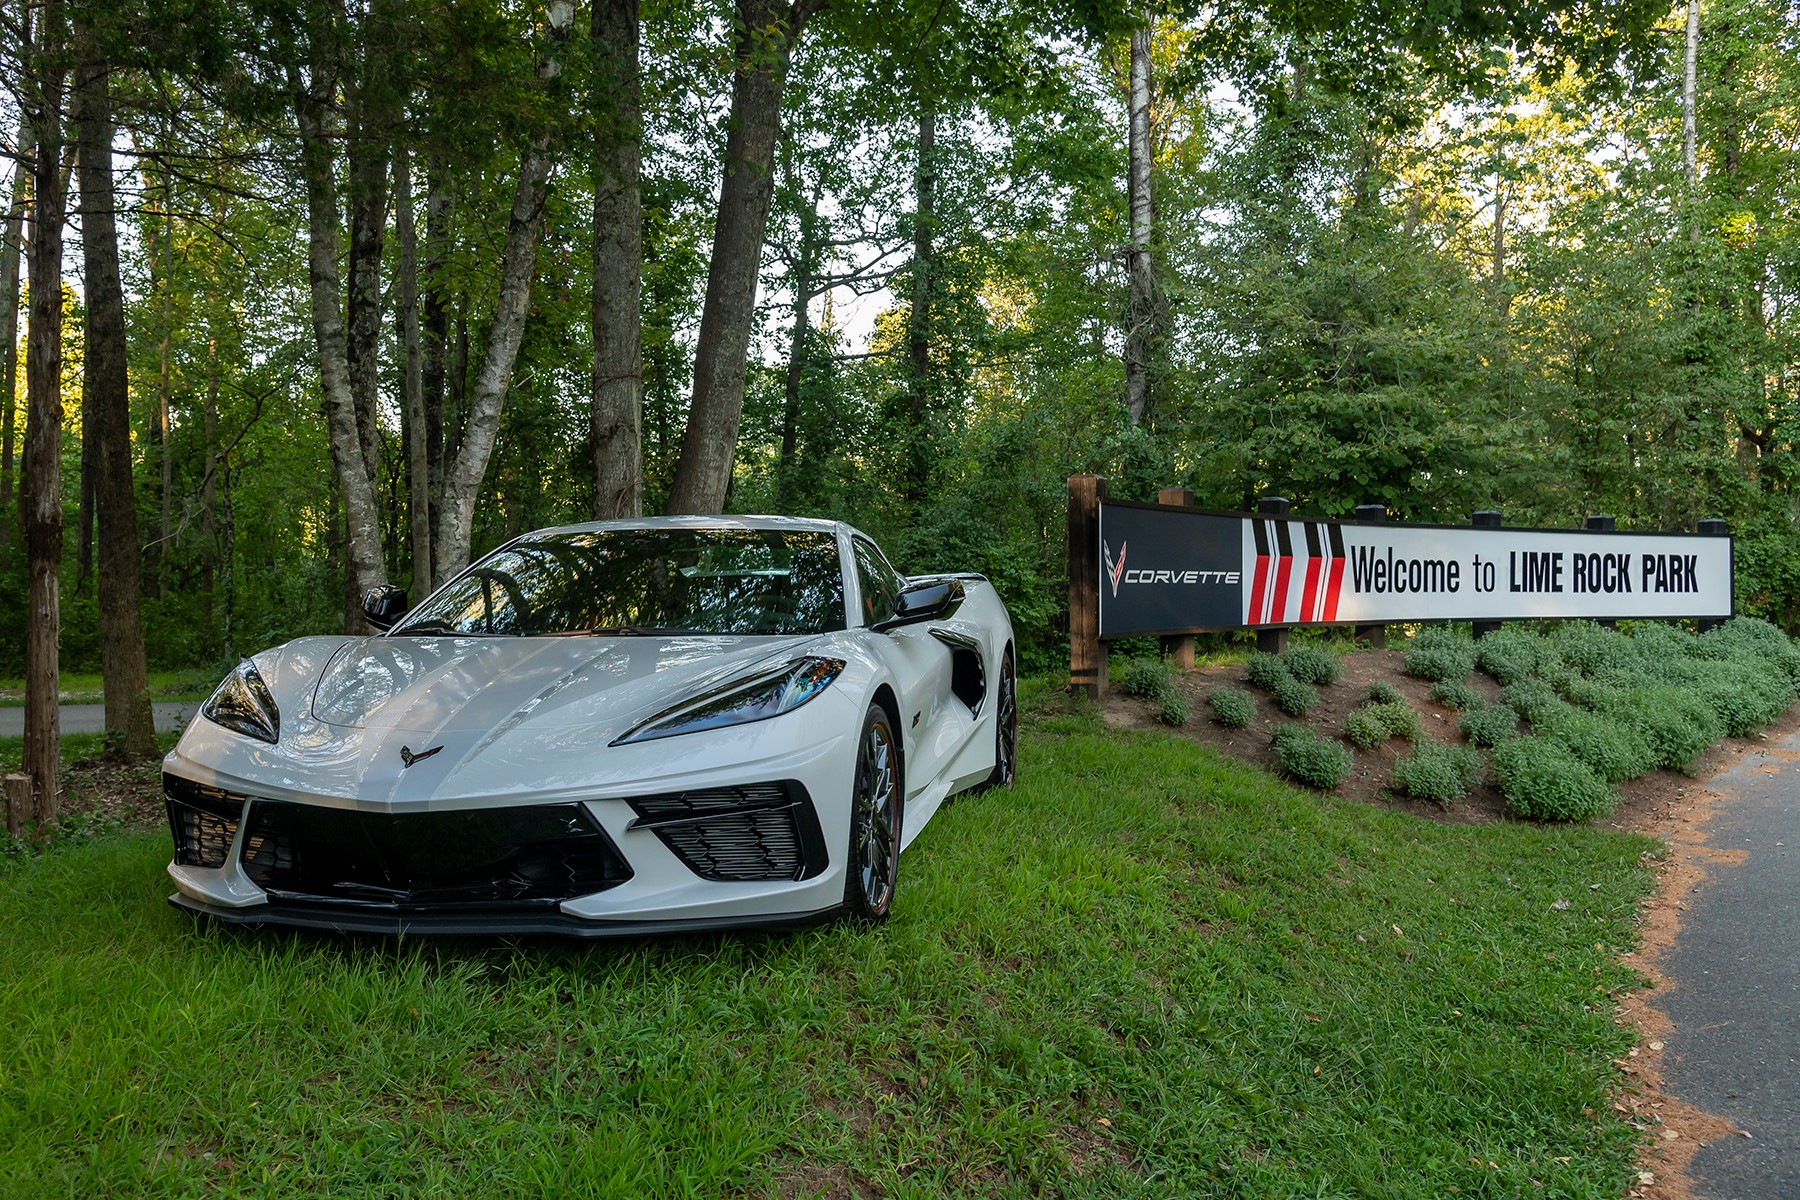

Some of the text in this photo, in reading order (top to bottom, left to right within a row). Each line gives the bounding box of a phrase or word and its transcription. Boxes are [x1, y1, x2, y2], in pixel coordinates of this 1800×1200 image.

[1124, 569, 1241, 584] CORVETTE
[1350, 545, 1699, 594] Welcome to LIME ROCK PARK
